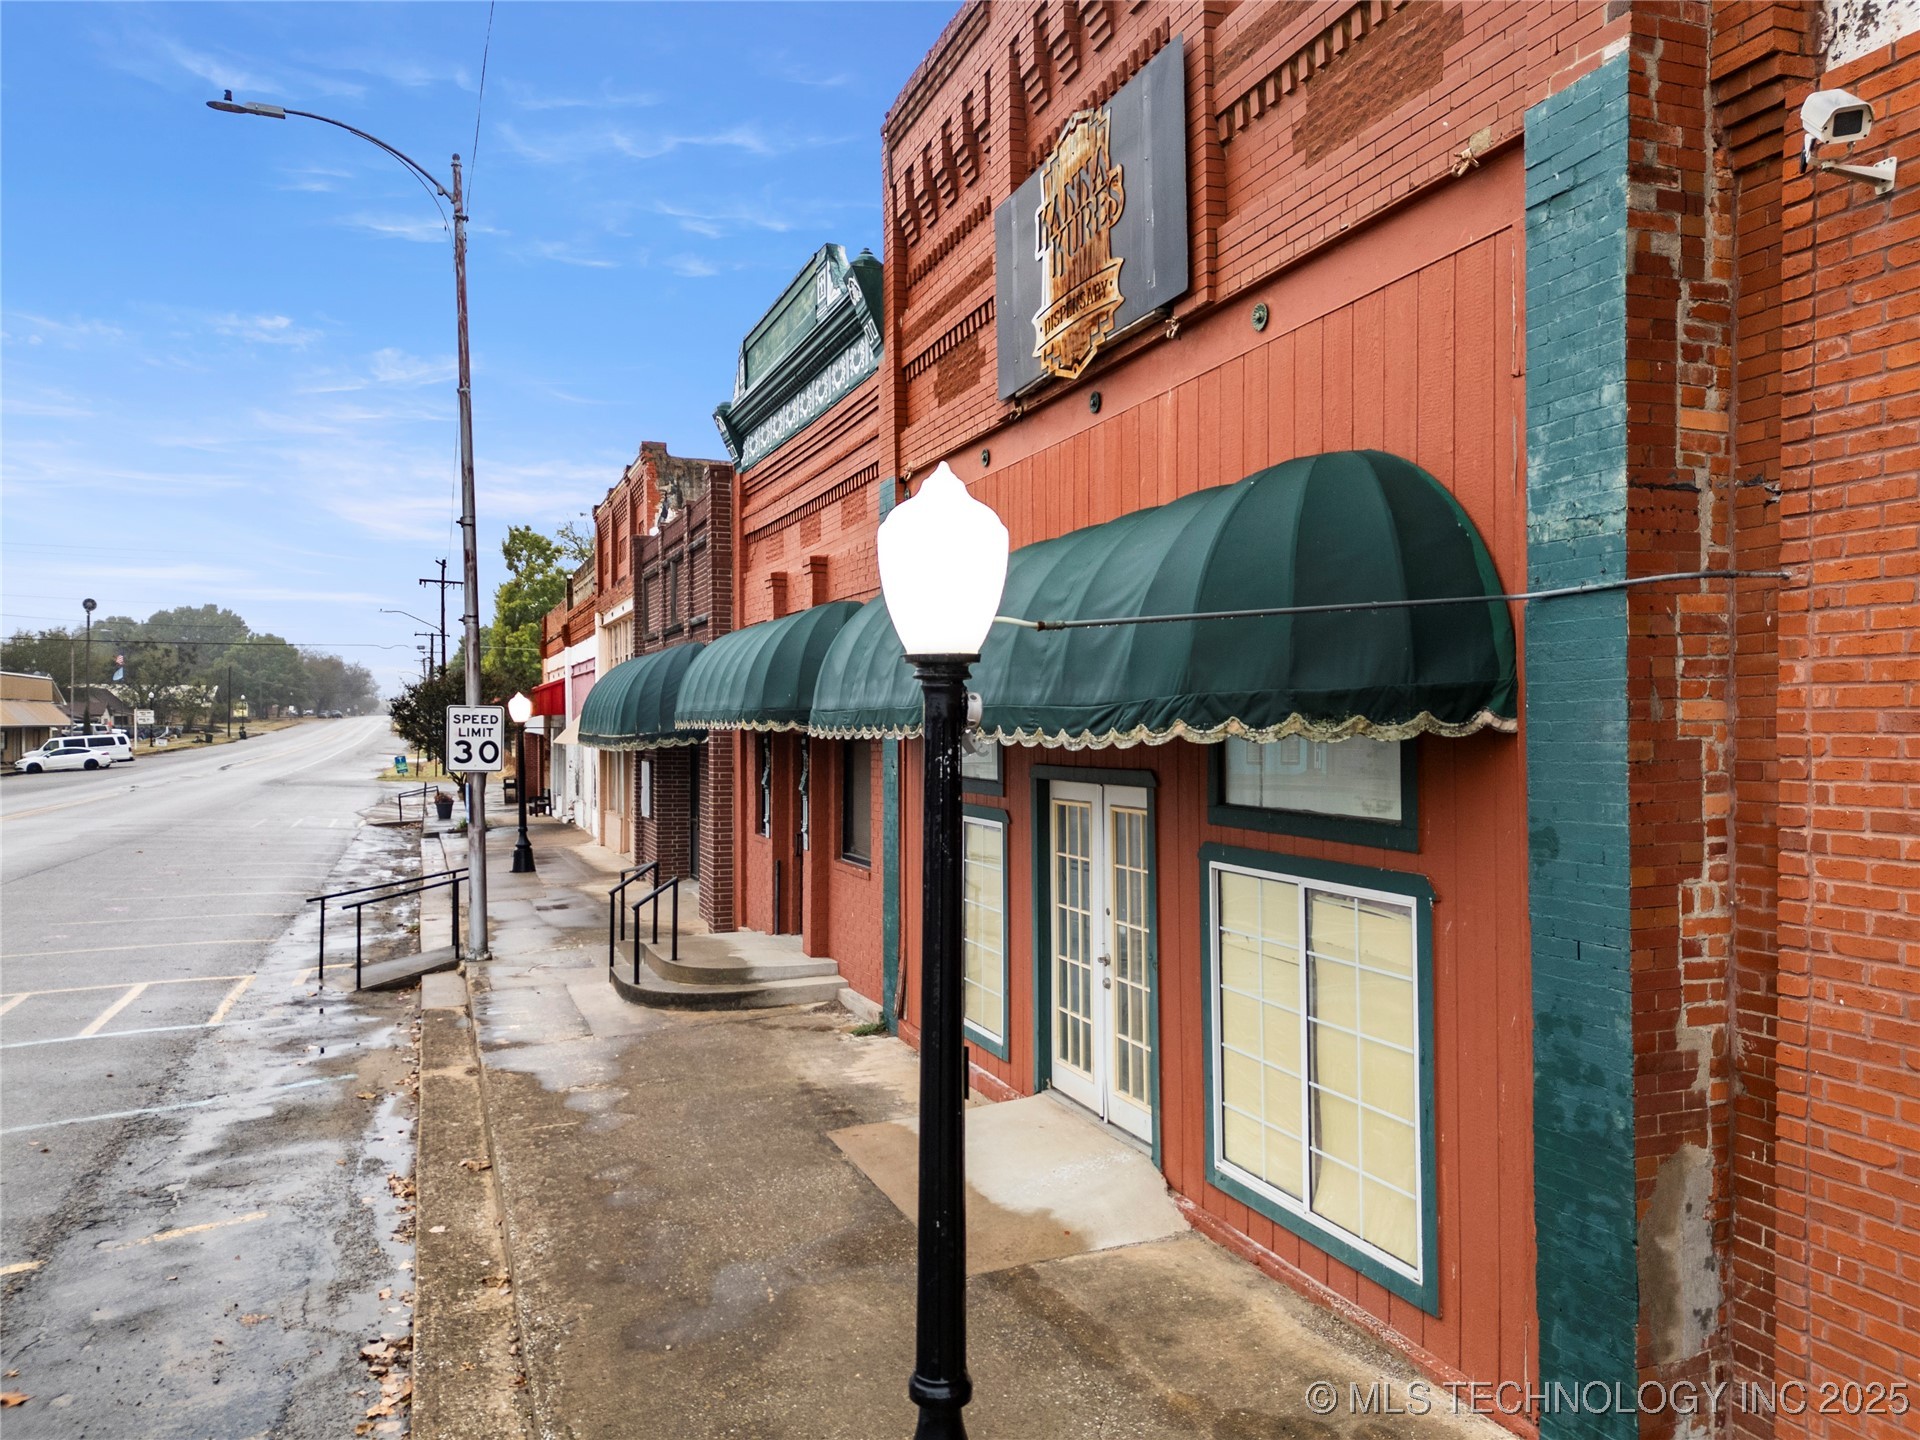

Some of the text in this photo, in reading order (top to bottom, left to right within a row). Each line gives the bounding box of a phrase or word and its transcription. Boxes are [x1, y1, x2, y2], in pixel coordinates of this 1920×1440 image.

[1038, 145, 1108, 253] KANNA
[1051, 172, 1120, 278] KURES
[1044, 279, 1108, 337] DISPENSARY
[453, 714, 499, 724] SPEED
[458, 727, 494, 737] LIMIT
[453, 740, 500, 764] 30
